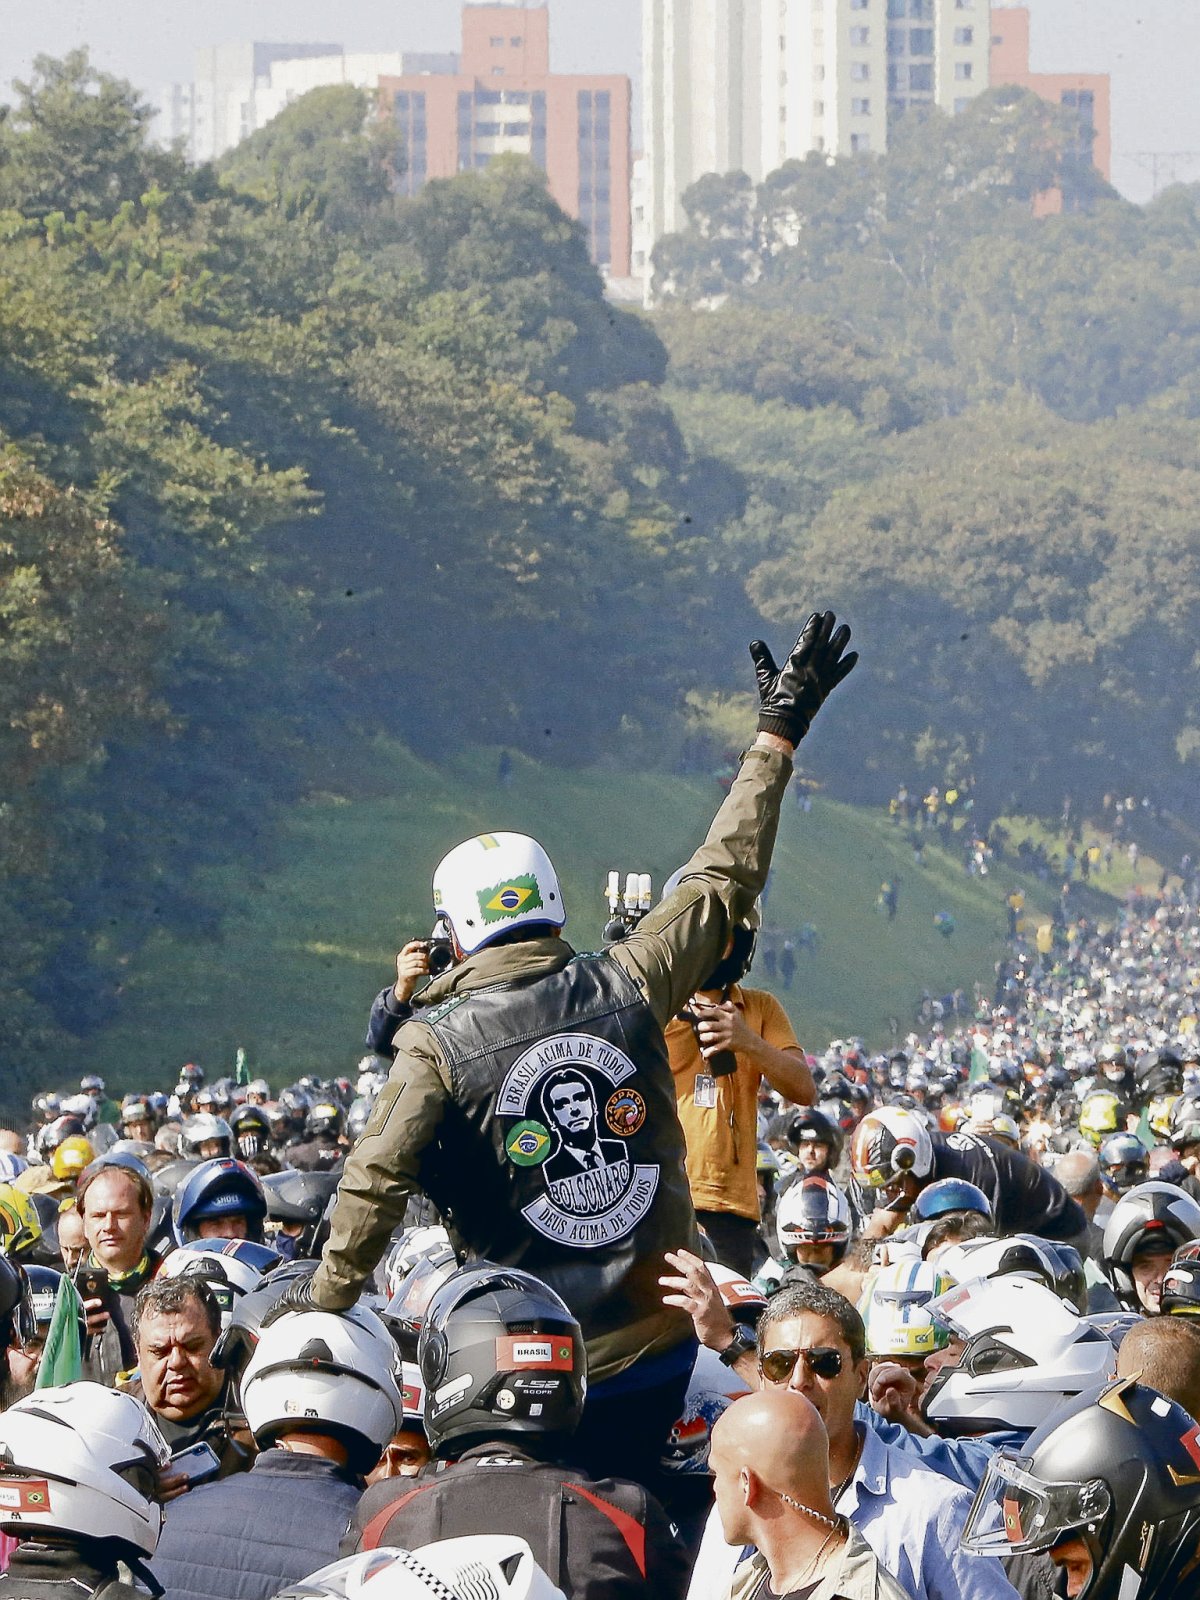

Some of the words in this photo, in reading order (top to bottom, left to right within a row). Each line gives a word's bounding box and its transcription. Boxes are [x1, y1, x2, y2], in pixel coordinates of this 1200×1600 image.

[506, 1062, 538, 1106] BRASIL
[537, 1041, 573, 1067] ACIMA
[578, 1042, 593, 1059] DE
[597, 1047, 625, 1076] TUDO
[549, 1161, 630, 1213] BOLSONARO
[538, 1208, 568, 1235] DEUS
[569, 1222, 608, 1241] ACIMA
[609, 1213, 628, 1233] DE
[623, 1179, 652, 1218] TODOS
[517, 1348, 549, 1356] BRASIL
[431, 1388, 465, 1420] LS2
[514, 1379, 560, 1389] LS2
